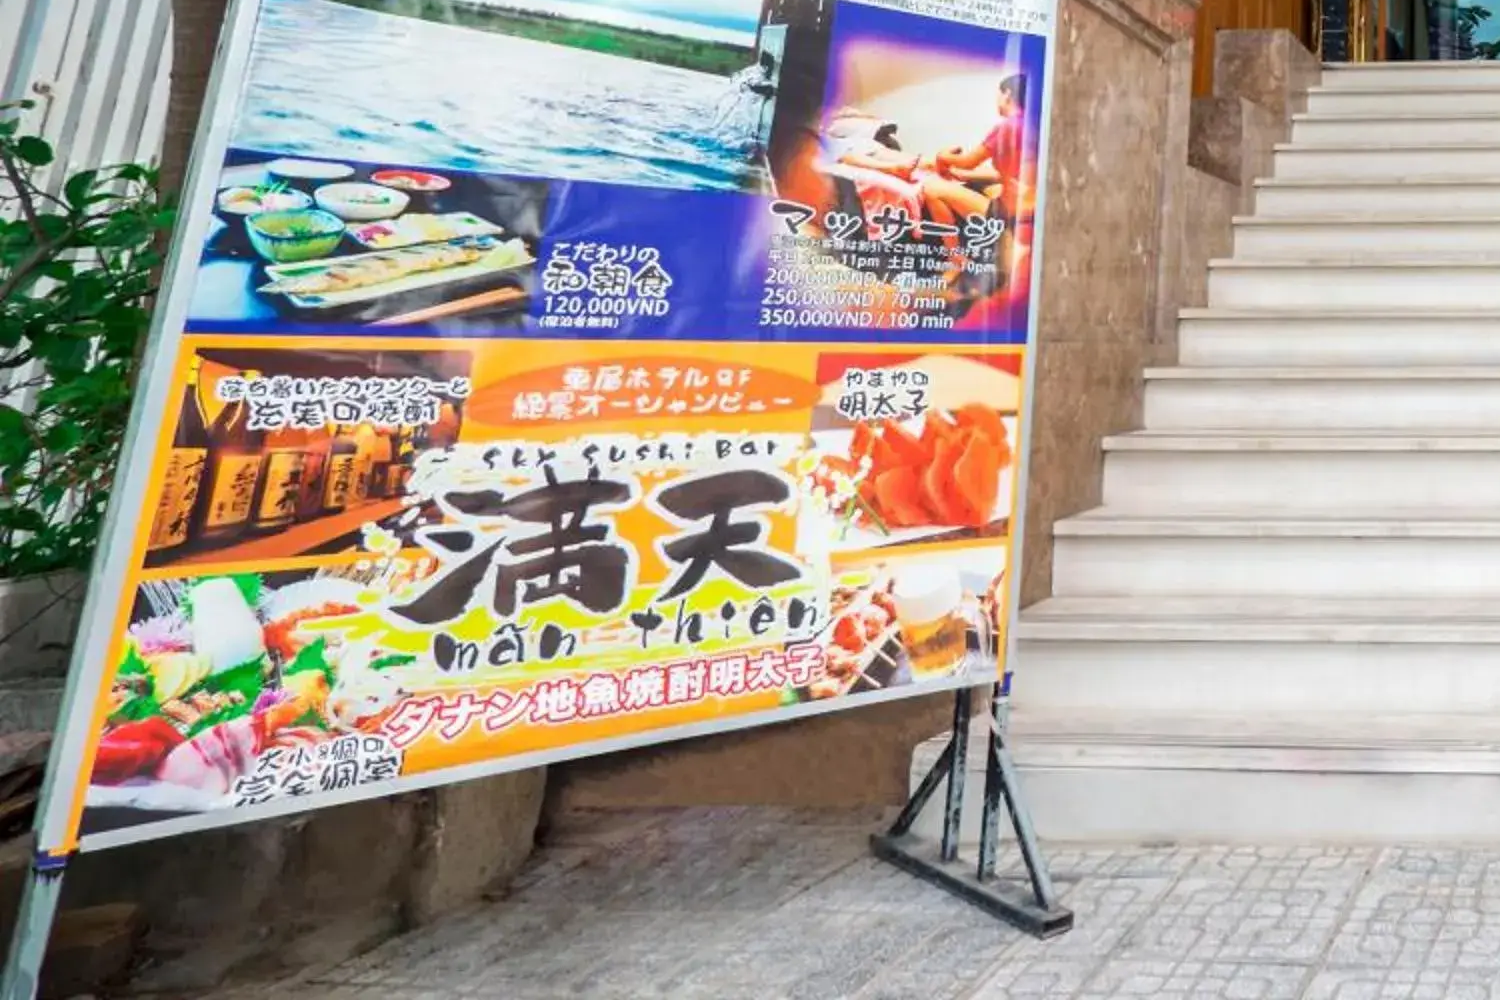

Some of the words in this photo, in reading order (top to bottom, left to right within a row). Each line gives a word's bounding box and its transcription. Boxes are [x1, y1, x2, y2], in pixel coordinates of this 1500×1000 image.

[771, 200, 1004, 248] マッサージ
[552, 242, 660, 262] こだわりの
[917, 273, 949, 290] min
[544, 295, 670, 317] 120,000VND
[914, 294, 945, 310] min
[759, 308, 873, 328] 350,000VND
[890, 311, 919, 328] 100
[922, 312, 954, 329] min
[846, 371, 929, 388] やまやの
[839, 388, 928, 416] 明太子
[387, 643, 827, 748] ダナン地魚焼酎明太子
